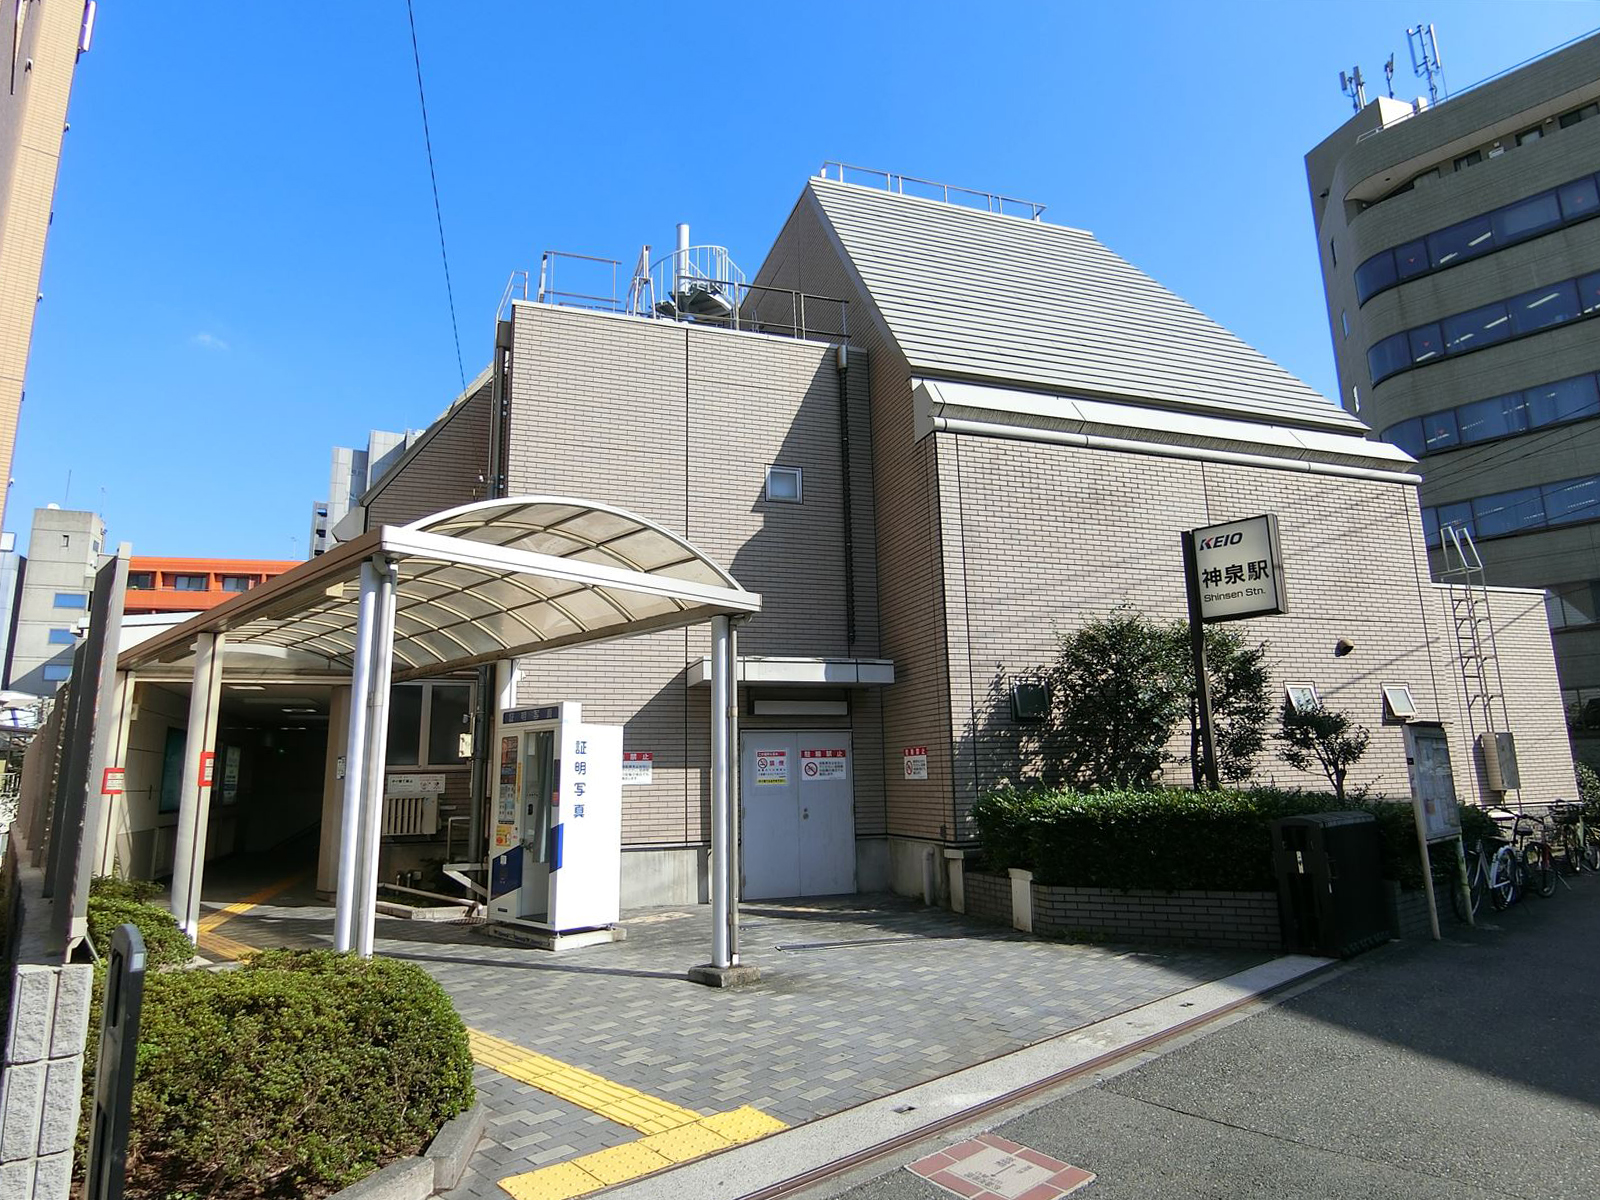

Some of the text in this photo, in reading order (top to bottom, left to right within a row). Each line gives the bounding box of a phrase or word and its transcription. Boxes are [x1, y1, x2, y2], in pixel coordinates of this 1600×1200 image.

[1199, 532, 1243, 551] KEIO
[1202, 559, 1270, 588] 神泉駅
[1203, 587, 1266, 603] Shinsen Stn.
[573, 740, 587, 818] 証明写真
